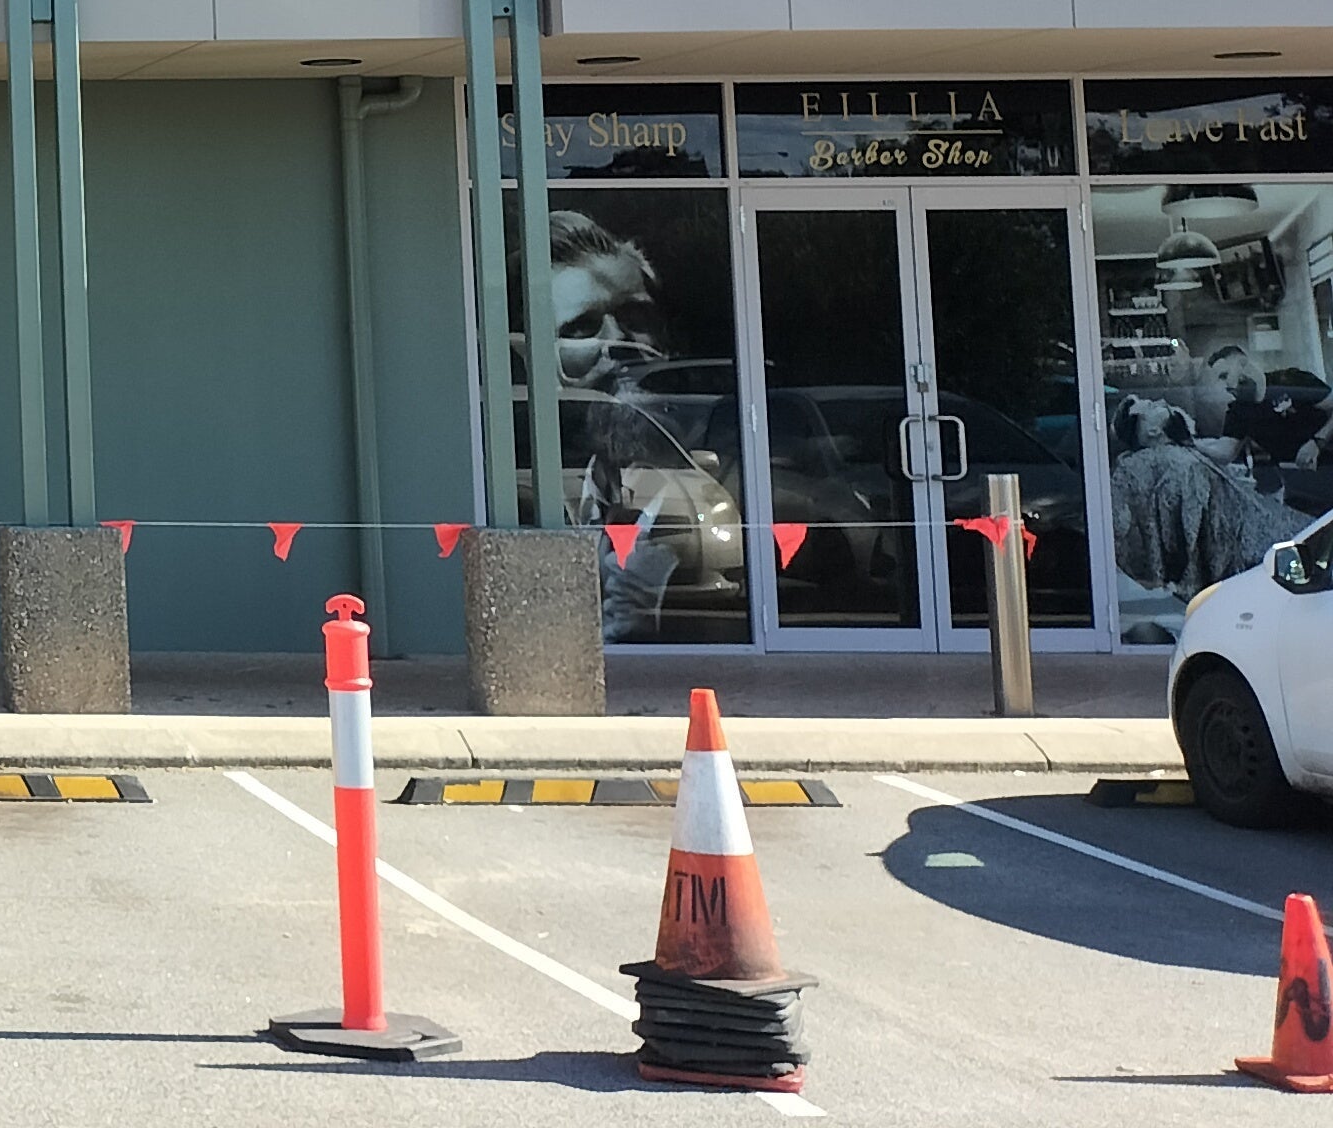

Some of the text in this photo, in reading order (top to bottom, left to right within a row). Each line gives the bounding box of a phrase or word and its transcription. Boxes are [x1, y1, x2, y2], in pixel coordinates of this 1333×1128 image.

[801, 90, 1003, 121] EILLIA
[500, 111, 687, 157] Say Sharp
[809, 139, 993, 171] Barber Shop
